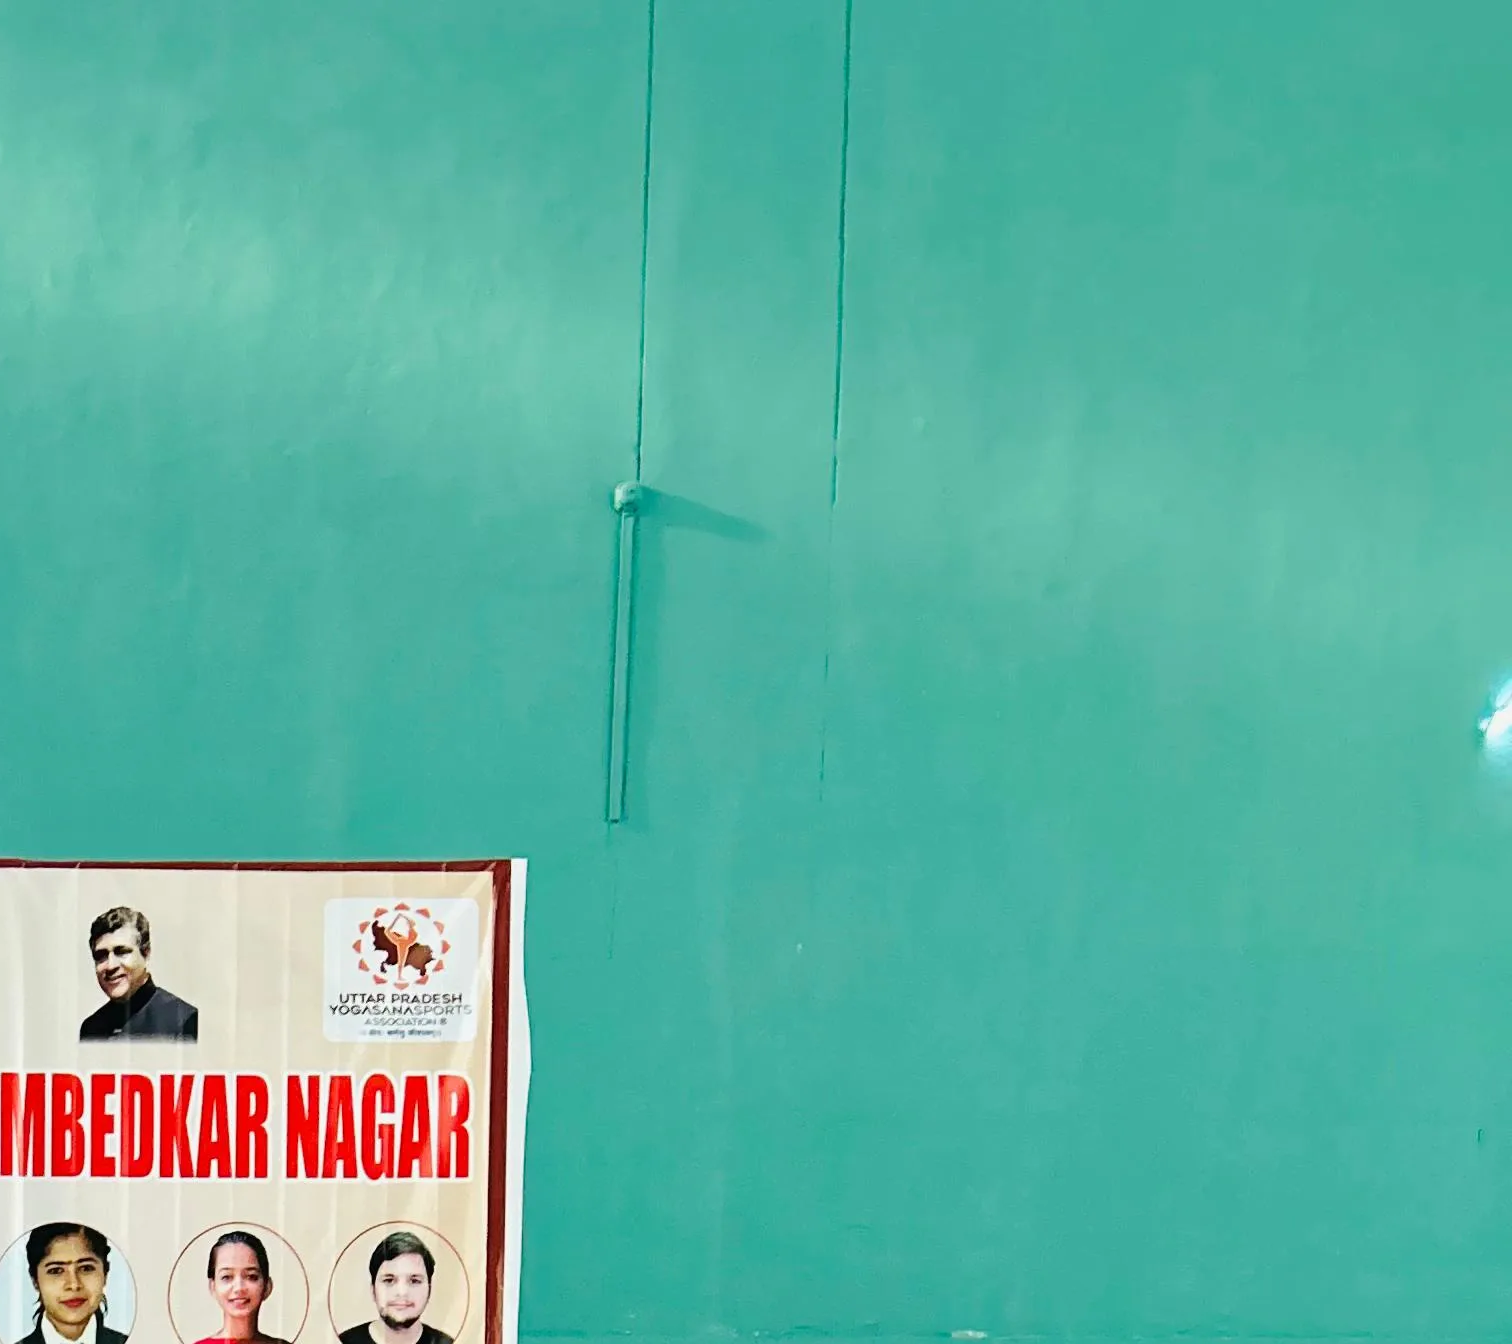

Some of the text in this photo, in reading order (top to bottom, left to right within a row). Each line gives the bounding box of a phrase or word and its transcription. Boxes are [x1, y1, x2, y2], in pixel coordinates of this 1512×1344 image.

[339, 993, 463, 1004] UTTAR PRADESH
[285, 1073, 472, 1180] NAGAR
